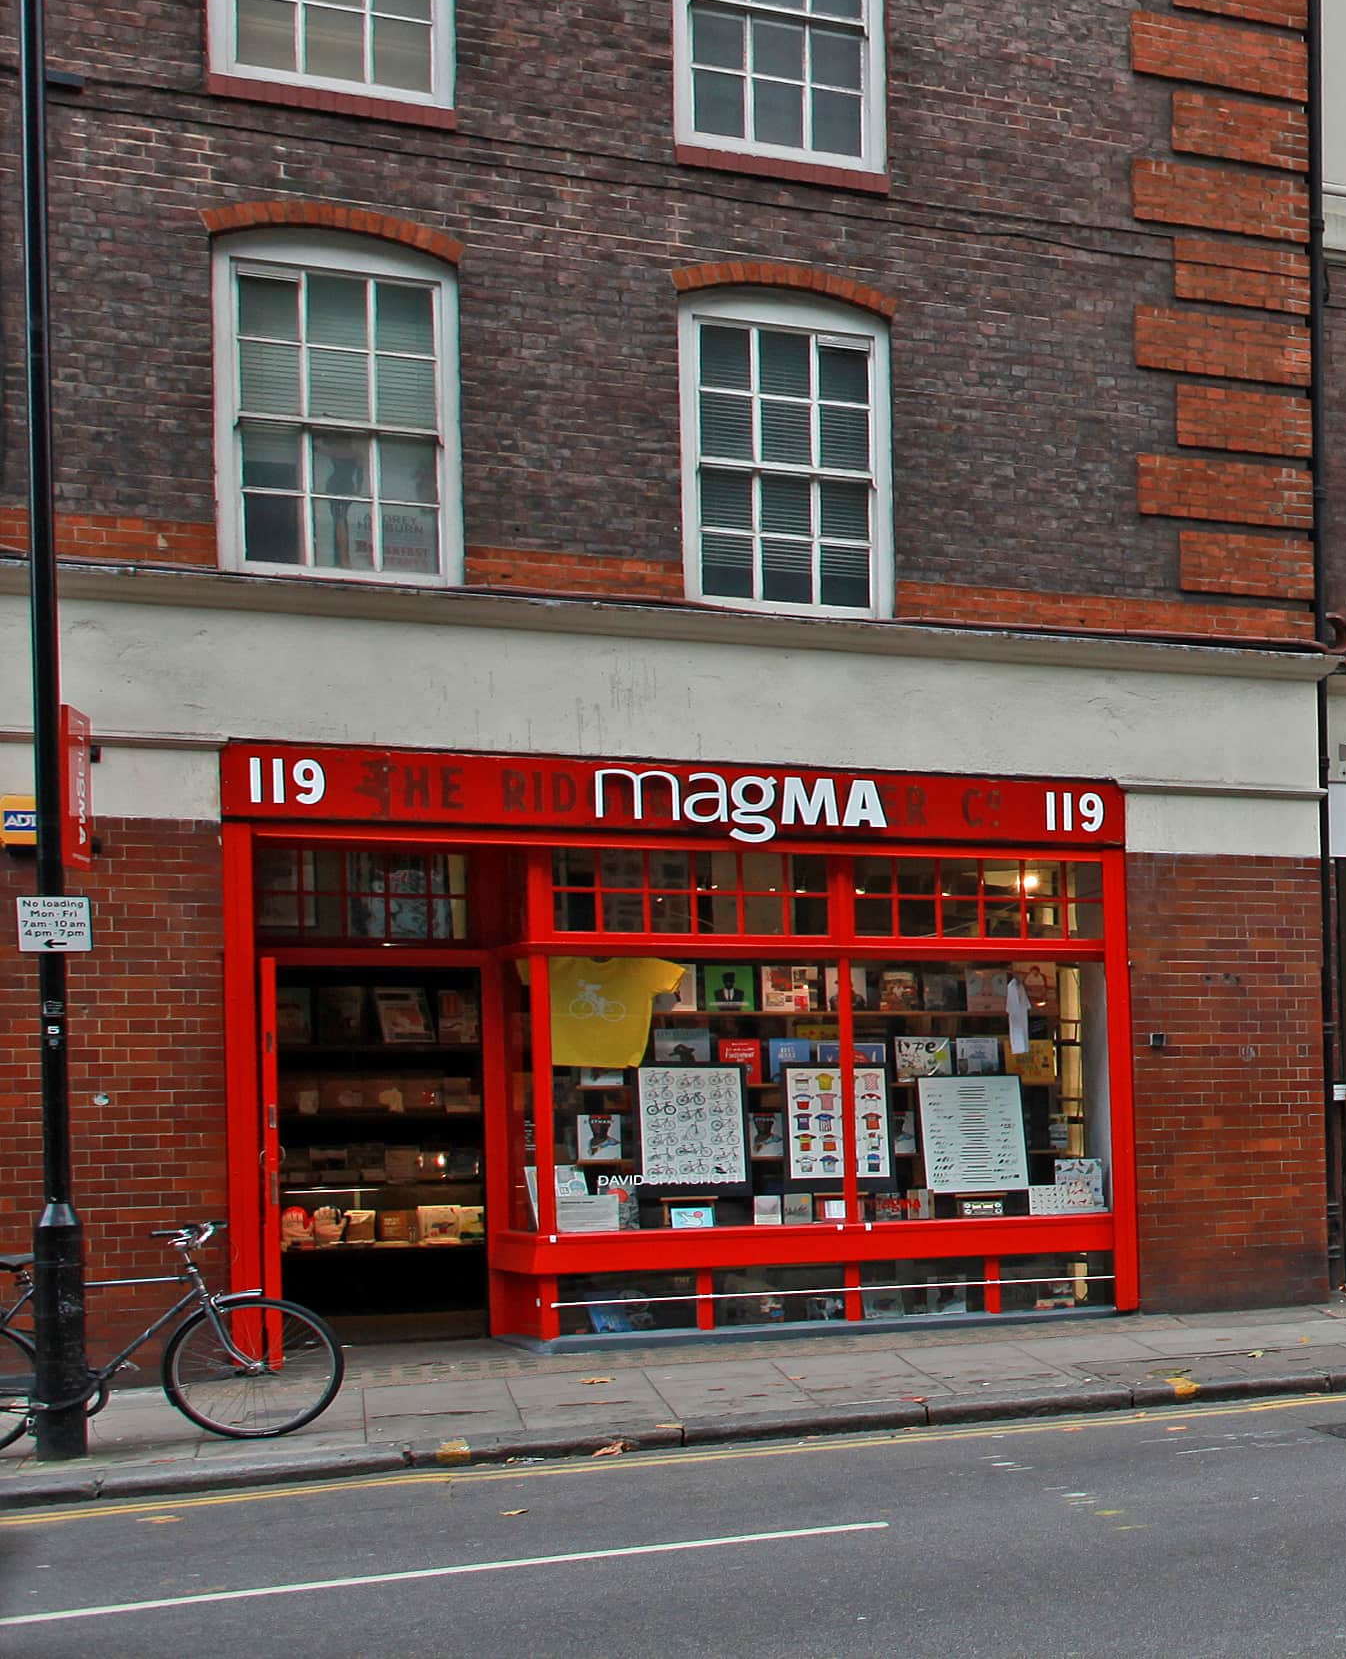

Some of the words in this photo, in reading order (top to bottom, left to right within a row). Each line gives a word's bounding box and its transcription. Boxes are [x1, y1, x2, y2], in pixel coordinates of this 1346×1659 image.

[249, 757, 325, 805] 119
[594, 768, 888, 843] magMA
[1045, 791, 1105, 832] 119
[22, 900, 39, 908] No
[42, 900, 84, 909] loading
[597, 1174, 643, 1186] DAVID
